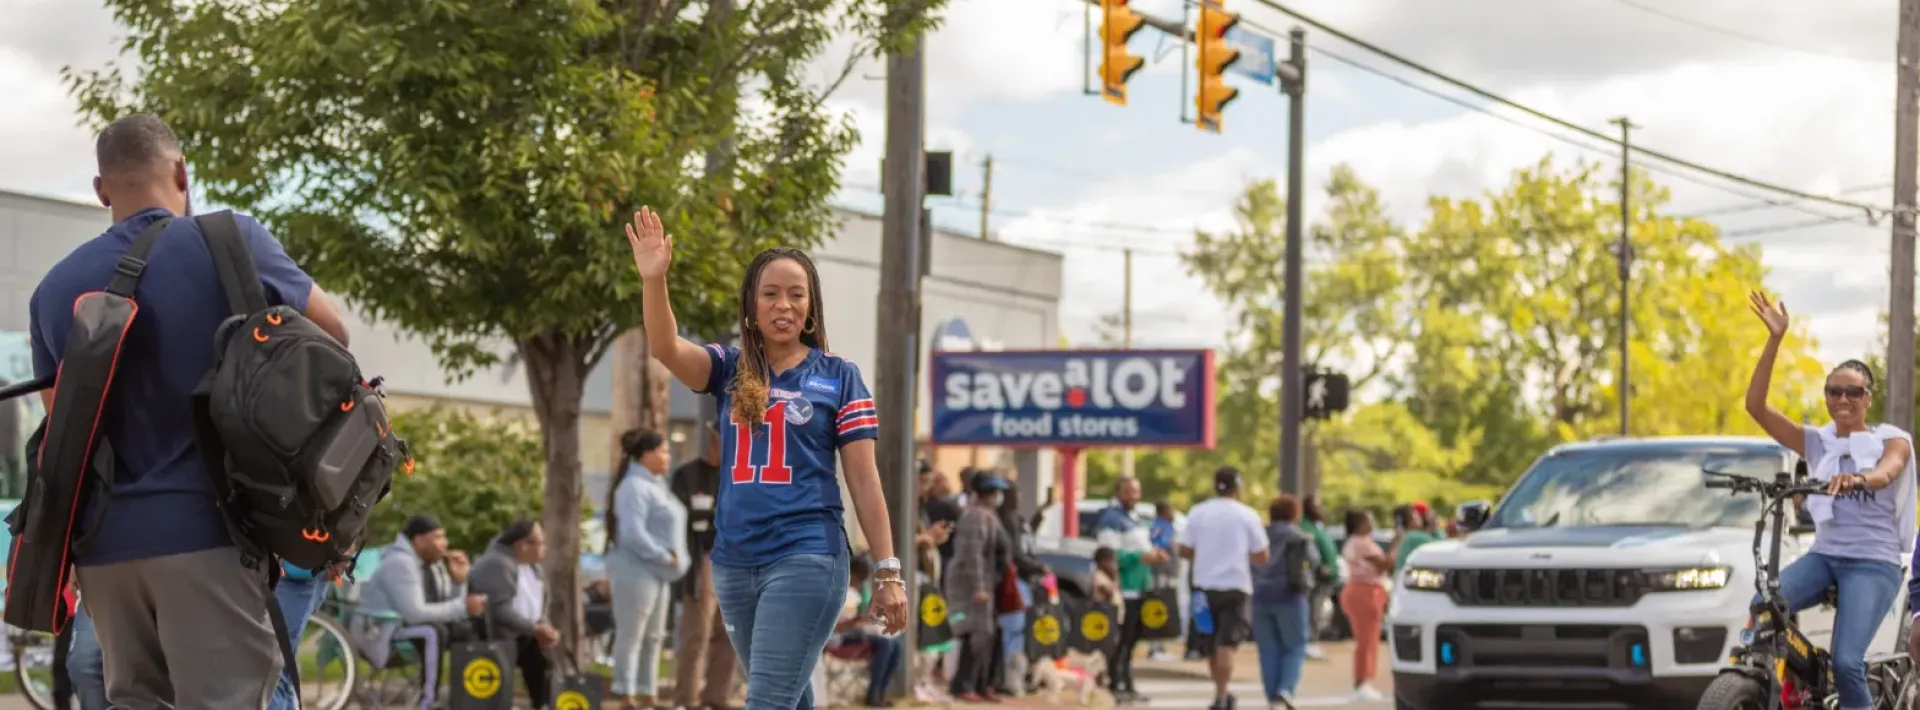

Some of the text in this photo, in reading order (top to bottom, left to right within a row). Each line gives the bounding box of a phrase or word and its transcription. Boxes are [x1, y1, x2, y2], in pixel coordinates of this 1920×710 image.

[730, 400, 793, 484] 11
[992, 412, 1139, 437] food stores
